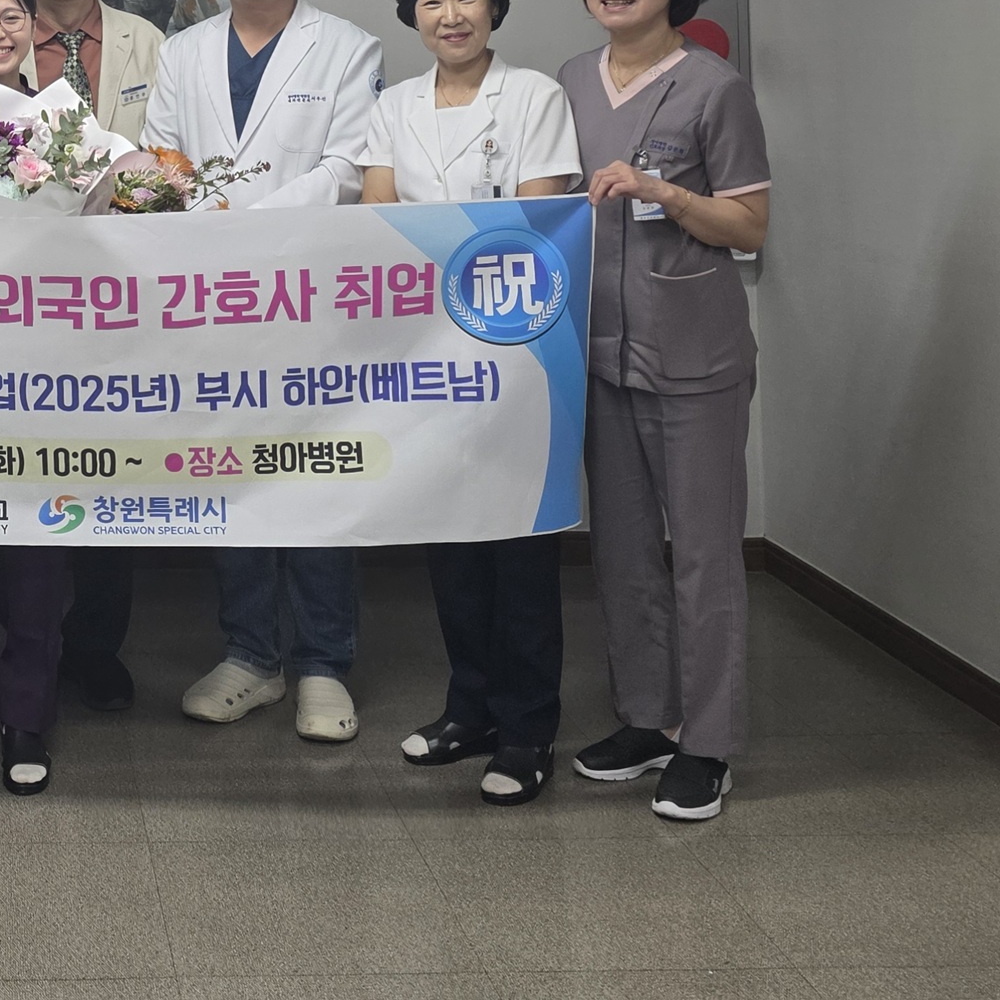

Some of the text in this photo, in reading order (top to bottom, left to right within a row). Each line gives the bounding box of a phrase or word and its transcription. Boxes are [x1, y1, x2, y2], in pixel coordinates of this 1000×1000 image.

[157, 268, 317, 330] 간호사
[334, 262, 435, 320] 취업
[473, 253, 544, 318] 祝
[195, 369, 268, 412] 부시
[281, 360, 500, 407] 하안(베트남)
[35, 447, 117, 478] 10:00
[187, 441, 364, 478] 장소 청아병원
[92, 495, 227, 524] 창원특례시
[92, 525, 227, 535] CHANGWON SPECIAL CITY
